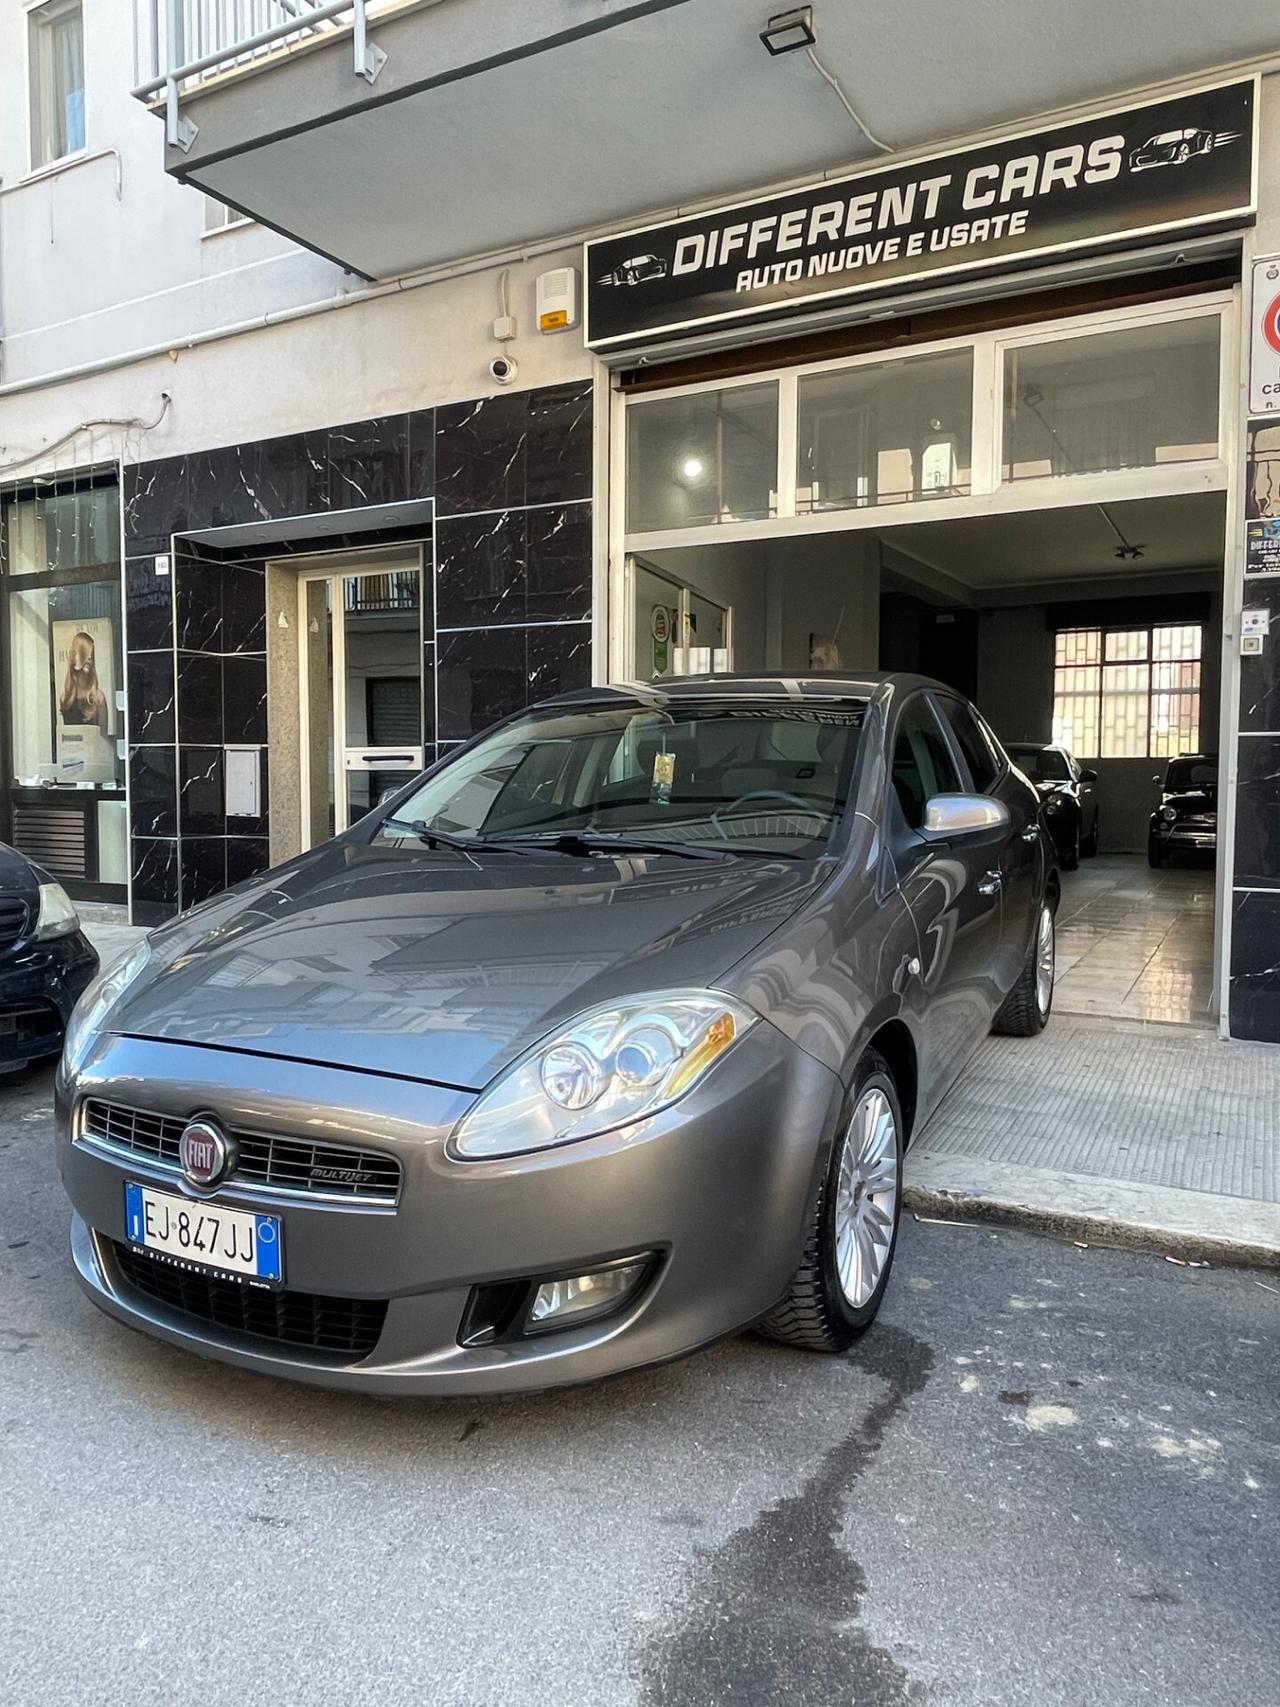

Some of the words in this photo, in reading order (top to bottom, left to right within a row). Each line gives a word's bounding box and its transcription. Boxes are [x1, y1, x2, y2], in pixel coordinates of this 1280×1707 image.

[672, 174, 951, 277] DIFFERENT
[961, 135, 1126, 211] CARS
[736, 258, 803, 293] AUTO
[807, 237, 901, 277] NUOVE
[906, 231, 925, 257] E
[929, 209, 1030, 252] USATE
[189, 1139, 213, 1169] FIAT
